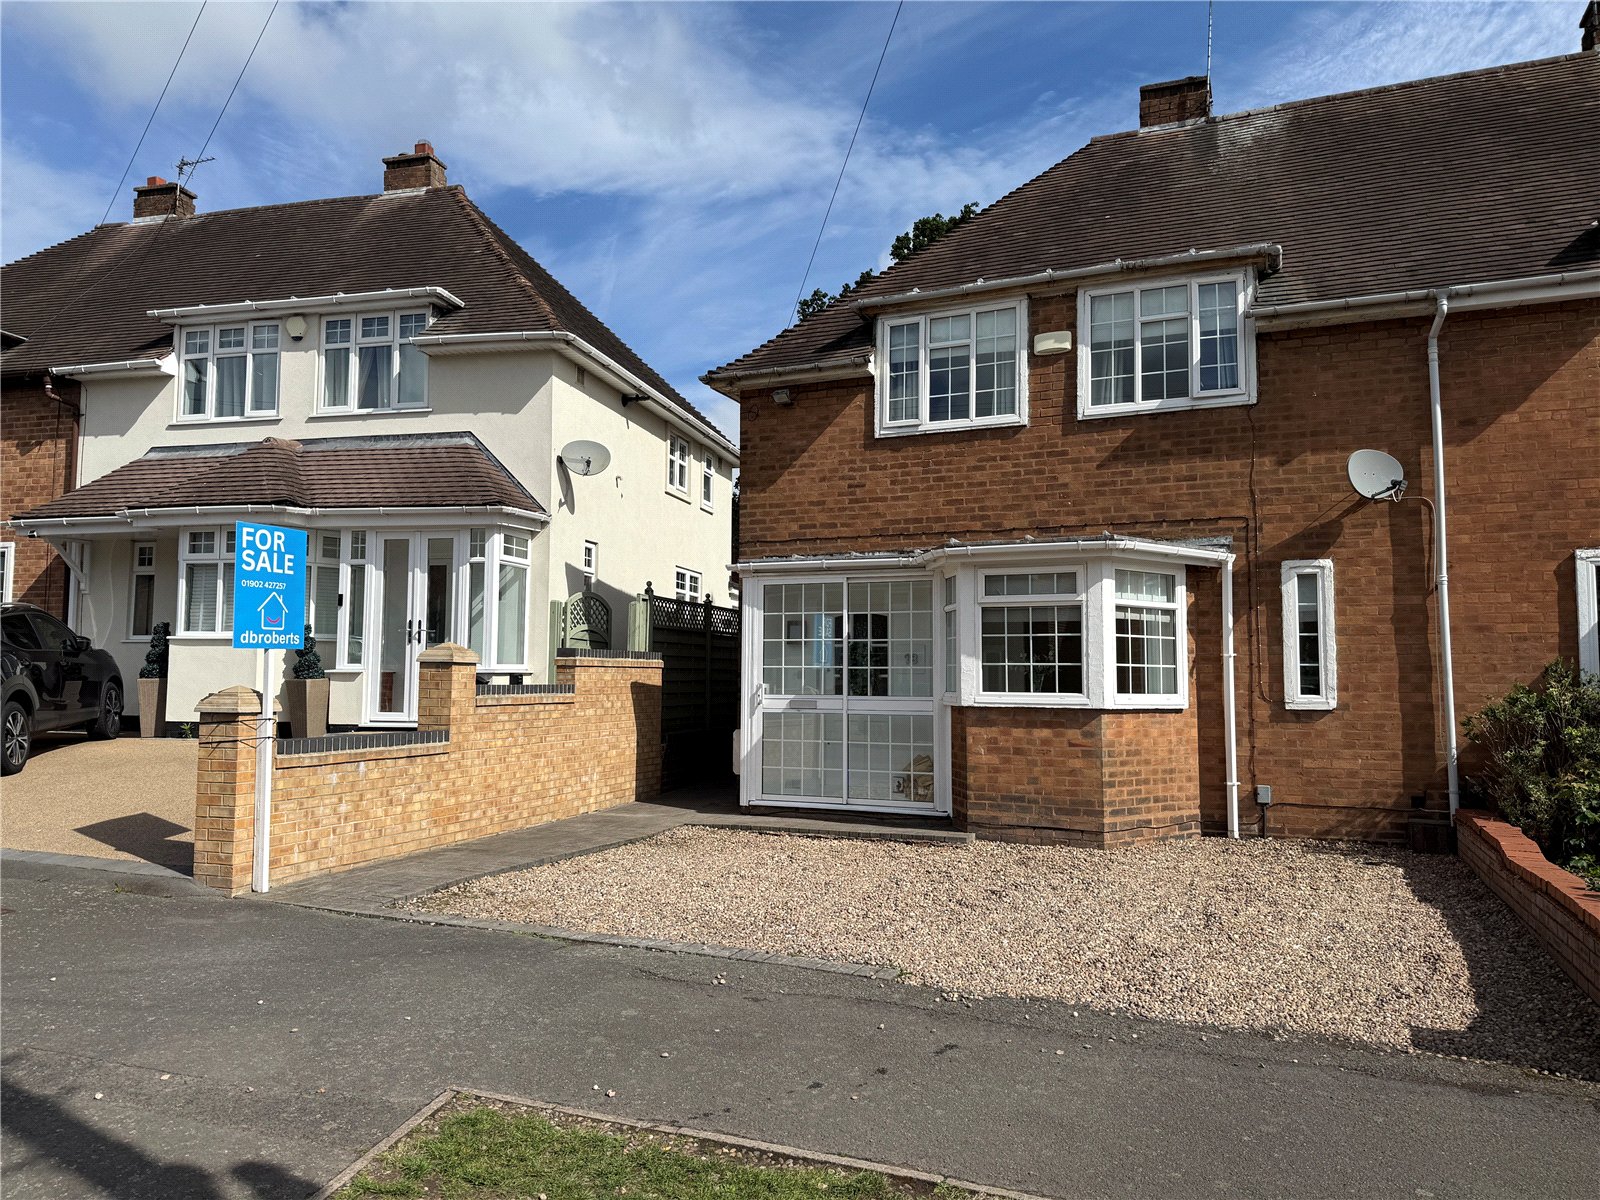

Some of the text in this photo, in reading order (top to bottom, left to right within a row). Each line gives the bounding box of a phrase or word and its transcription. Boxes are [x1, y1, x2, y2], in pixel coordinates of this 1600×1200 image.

[242, 527, 285, 552] FOR
[242, 549, 294, 575] SALE
[241, 579, 287, 590] 01902 427257
[240, 630, 300, 645] dbroberts
